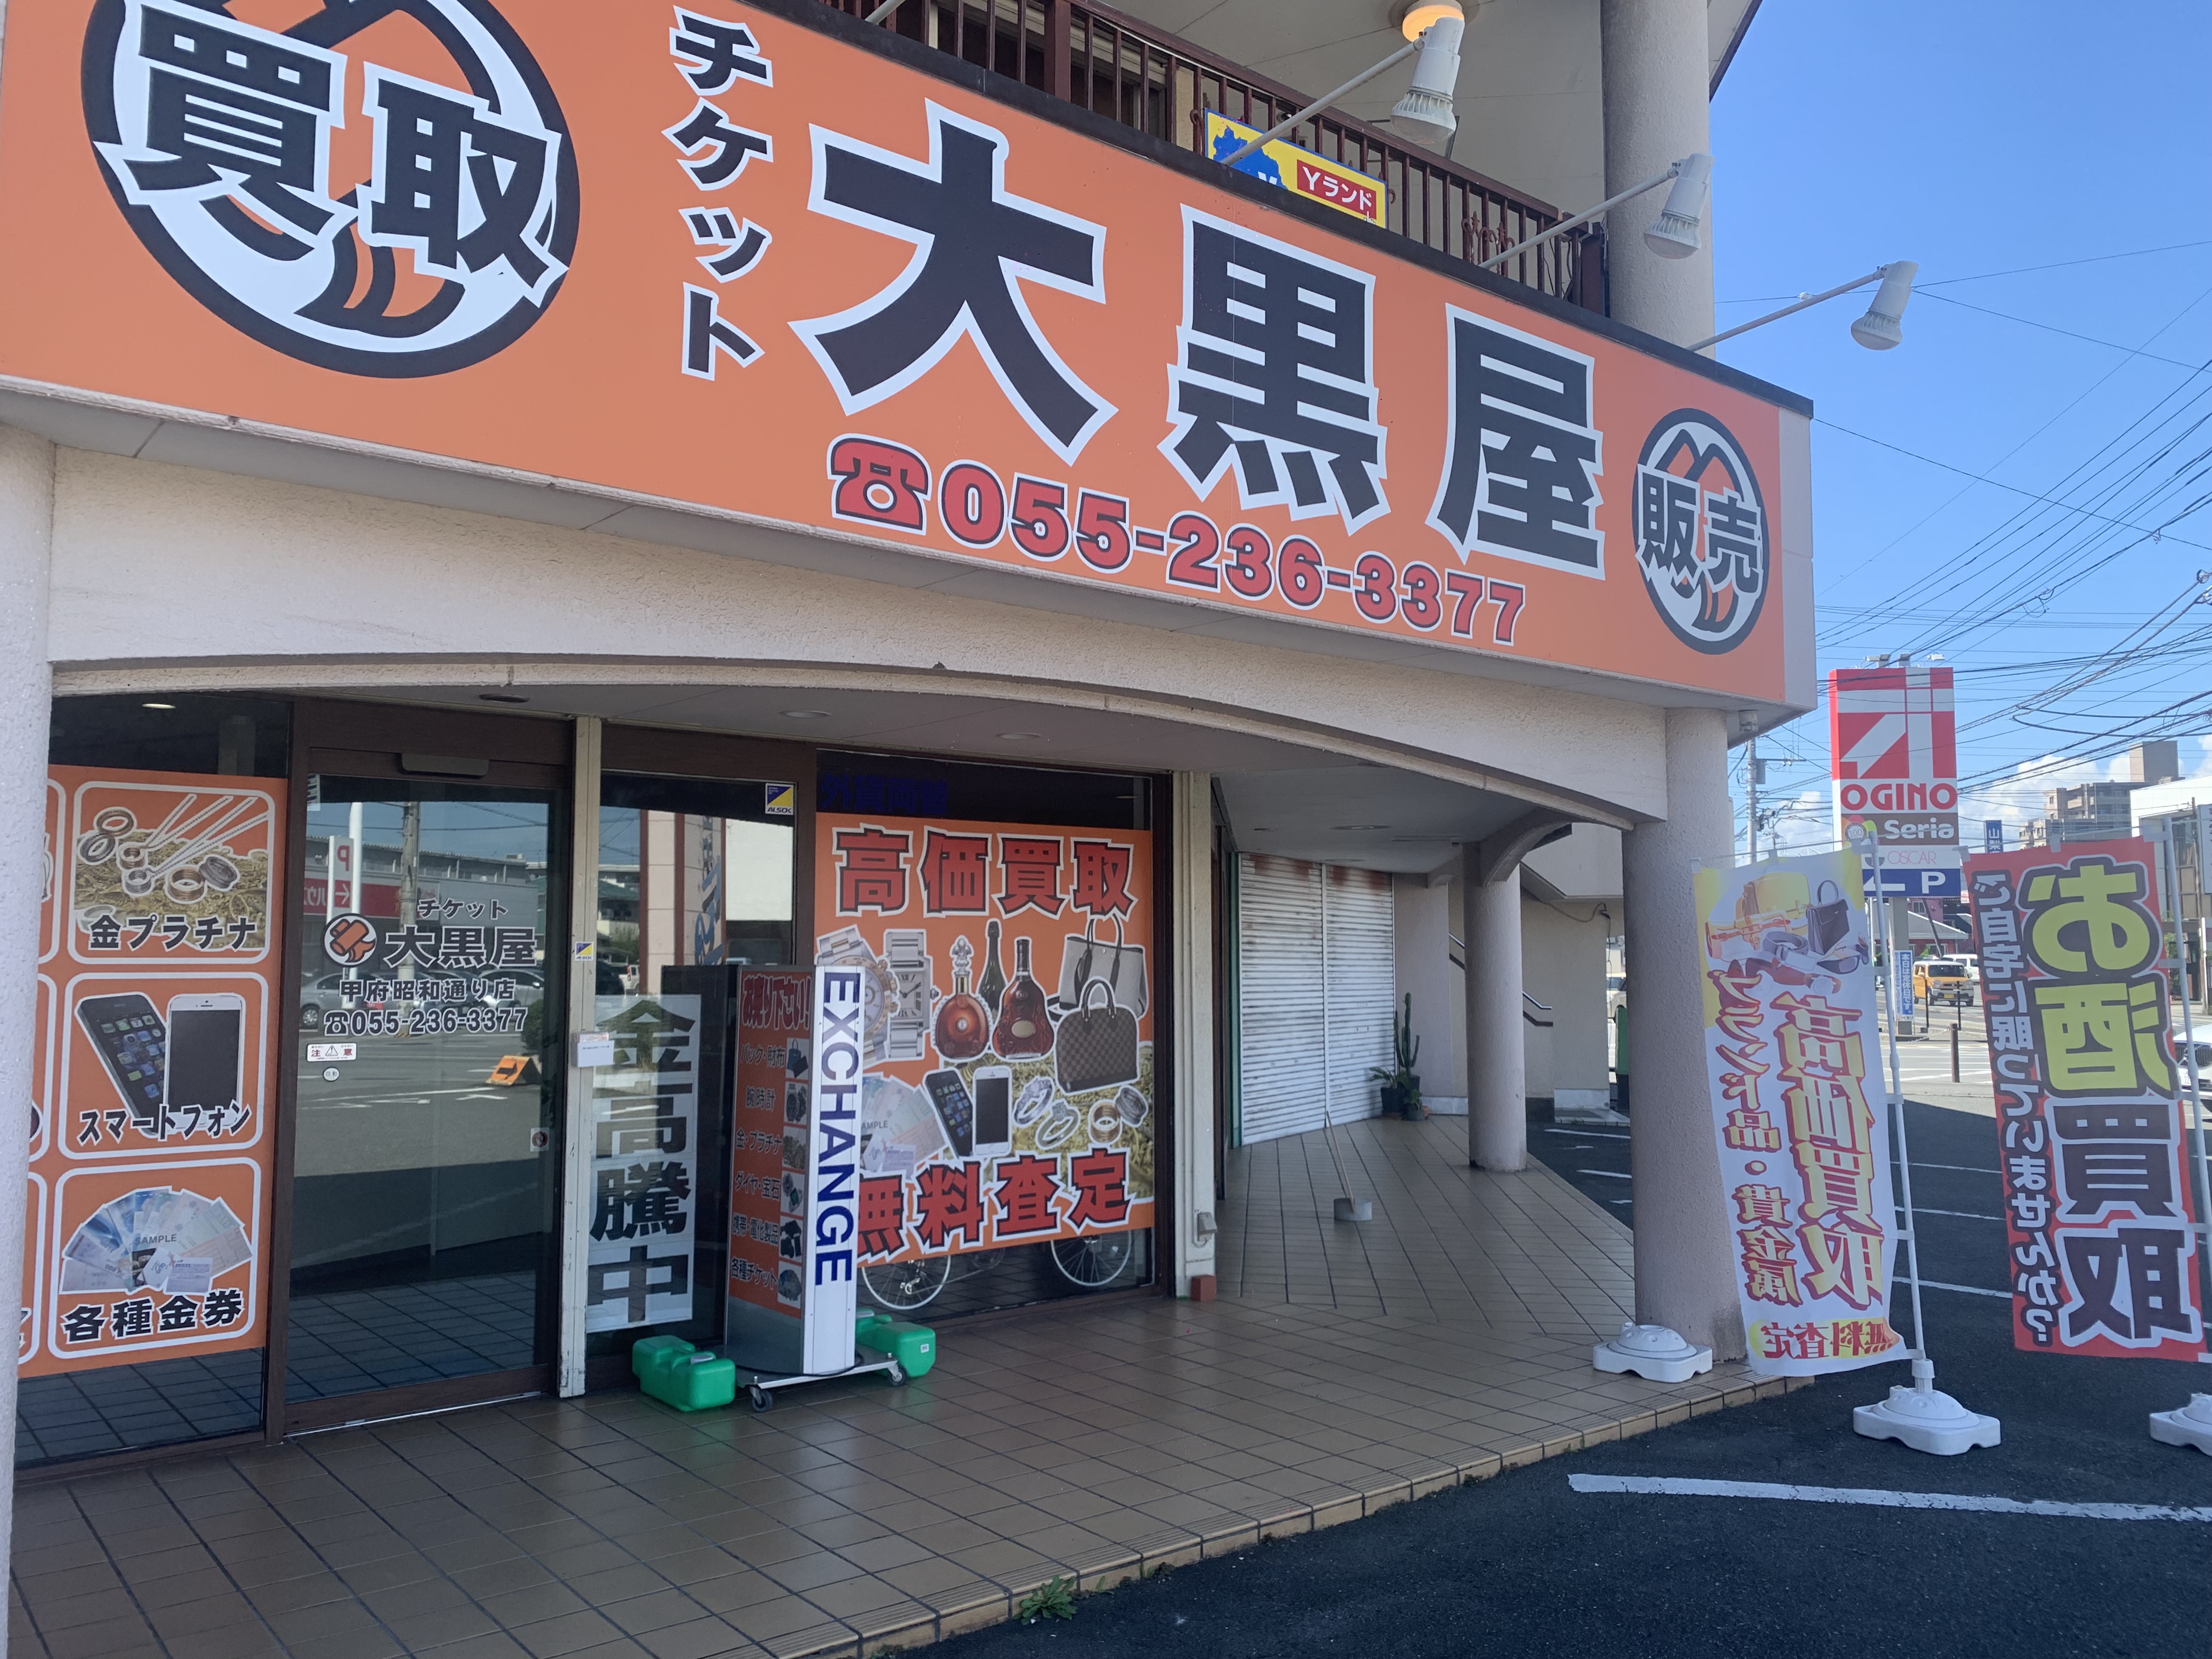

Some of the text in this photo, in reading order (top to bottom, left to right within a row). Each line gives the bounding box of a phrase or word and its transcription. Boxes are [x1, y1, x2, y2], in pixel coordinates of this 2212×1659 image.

[122, 3, 550, 291] 買取
[669, 11, 770, 375] チケット
[1302, 166, 1373, 212] Yランド
[811, 116, 1601, 571] 大黒屋
[940, 460, 1525, 645] 055-236-3377
[1640, 470, 1761, 595] 販売
[1840, 782, 1958, 811] OGINO
[1848, 828, 1863, 838] 100
[1884, 817, 1955, 839] Seria
[1988, 827, 2001, 854] 山梨
[834, 825, 1136, 919] 高価買取
[1887, 850, 1937, 865] OSCAR
[1921, 871, 1946, 894] P
[416, 898, 508, 920] チケット
[88, 913, 256, 951] 金プラチナ
[383, 924, 538, 969] 大黒屋
[340, 978, 516, 1002] 甲府昭和通り店
[350, 1007, 528, 1036] 055-236-3377
[77, 1101, 252, 1144] スマートフォン
[815, 972, 862, 1286] EXCHANGE
[861, 1120, 889, 1130] AMPLE
[587, 999, 696, 1323] 金高騰中
[856, 1148, 1132, 1257] 無料査定
[134, 1233, 177, 1245] SAMPLE
[63, 1289, 245, 1343] 各種金券
